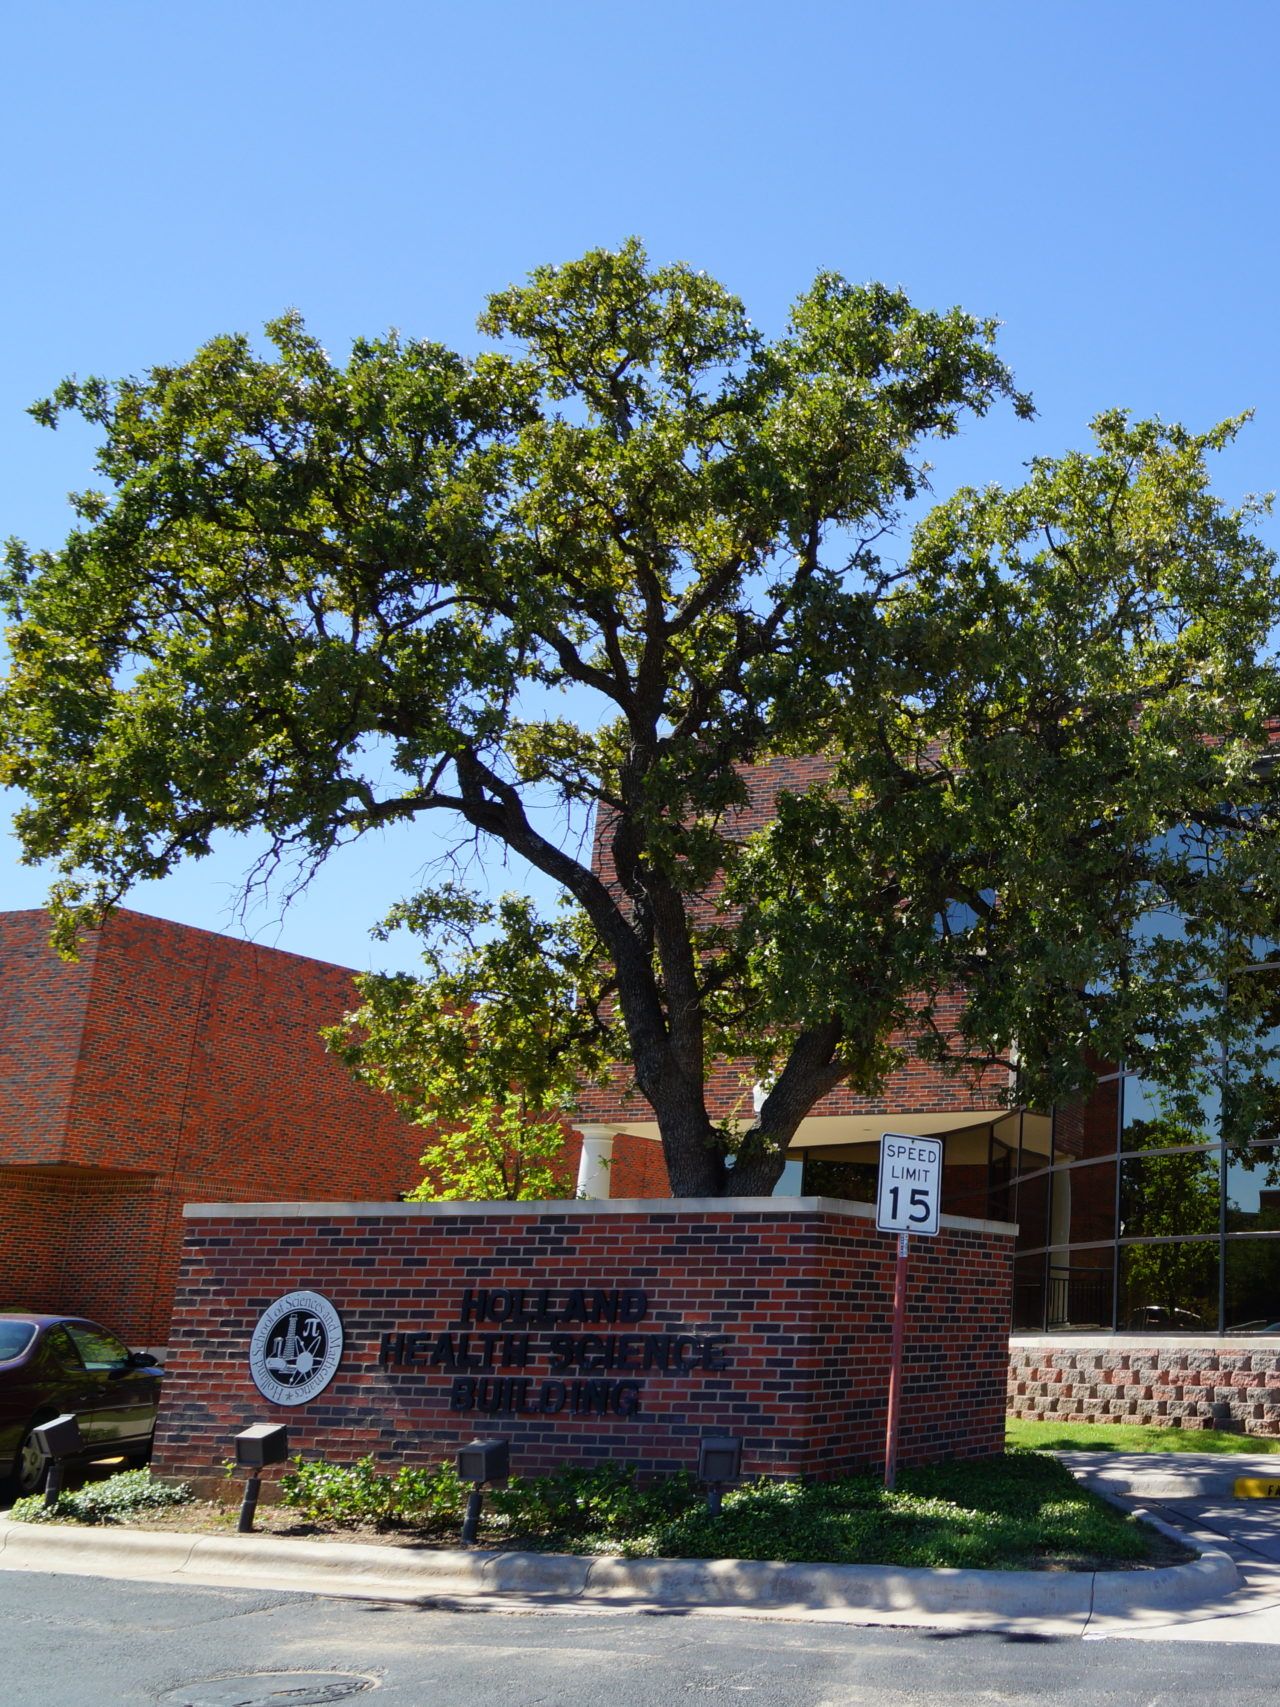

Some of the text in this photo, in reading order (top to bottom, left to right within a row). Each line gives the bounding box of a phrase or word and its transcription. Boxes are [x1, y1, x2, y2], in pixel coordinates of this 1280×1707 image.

[887, 1145, 937, 1164] SPEED
[891, 1165, 931, 1183] LIMIT
[889, 1186, 931, 1223] 15
[461, 1289, 649, 1324] HOLLAND
[252, 1293, 342, 1401] Holland School of Sciences and Mathematics
[379, 1332, 729, 1371] HEALTH SCIENCE
[450, 1376, 640, 1416] BUILDING
